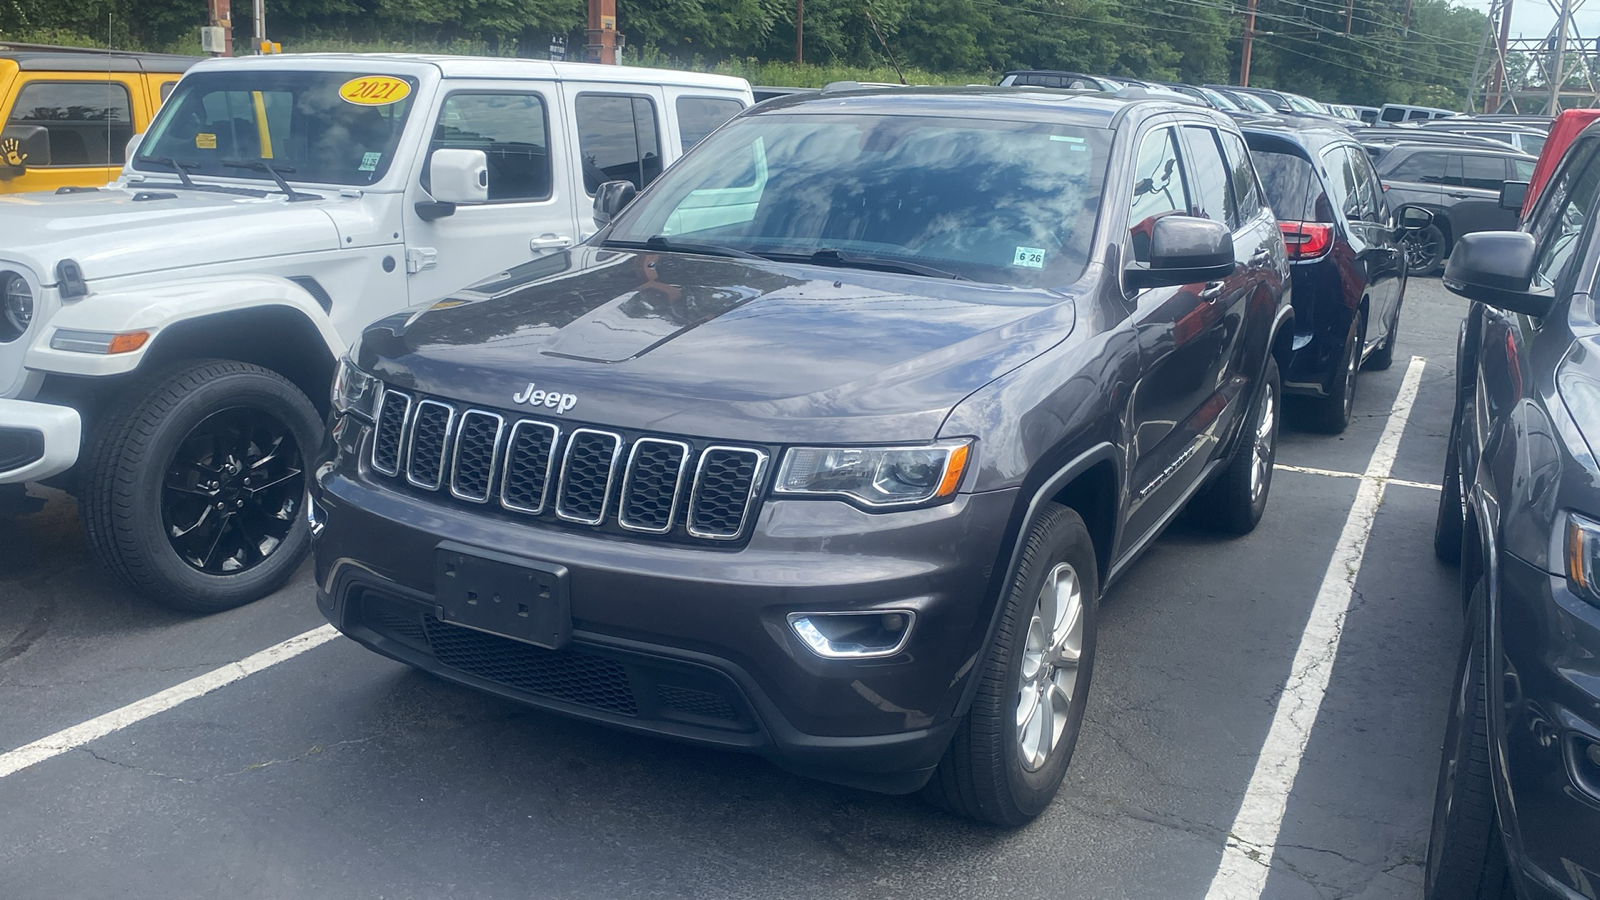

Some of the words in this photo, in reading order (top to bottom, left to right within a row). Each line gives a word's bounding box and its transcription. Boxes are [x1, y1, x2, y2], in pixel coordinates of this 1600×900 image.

[347, 81, 400, 99] 2021
[1019, 252, 1026, 261] 6
[1029, 253, 1042, 263] 26
[513, 382, 578, 415] Jeep
